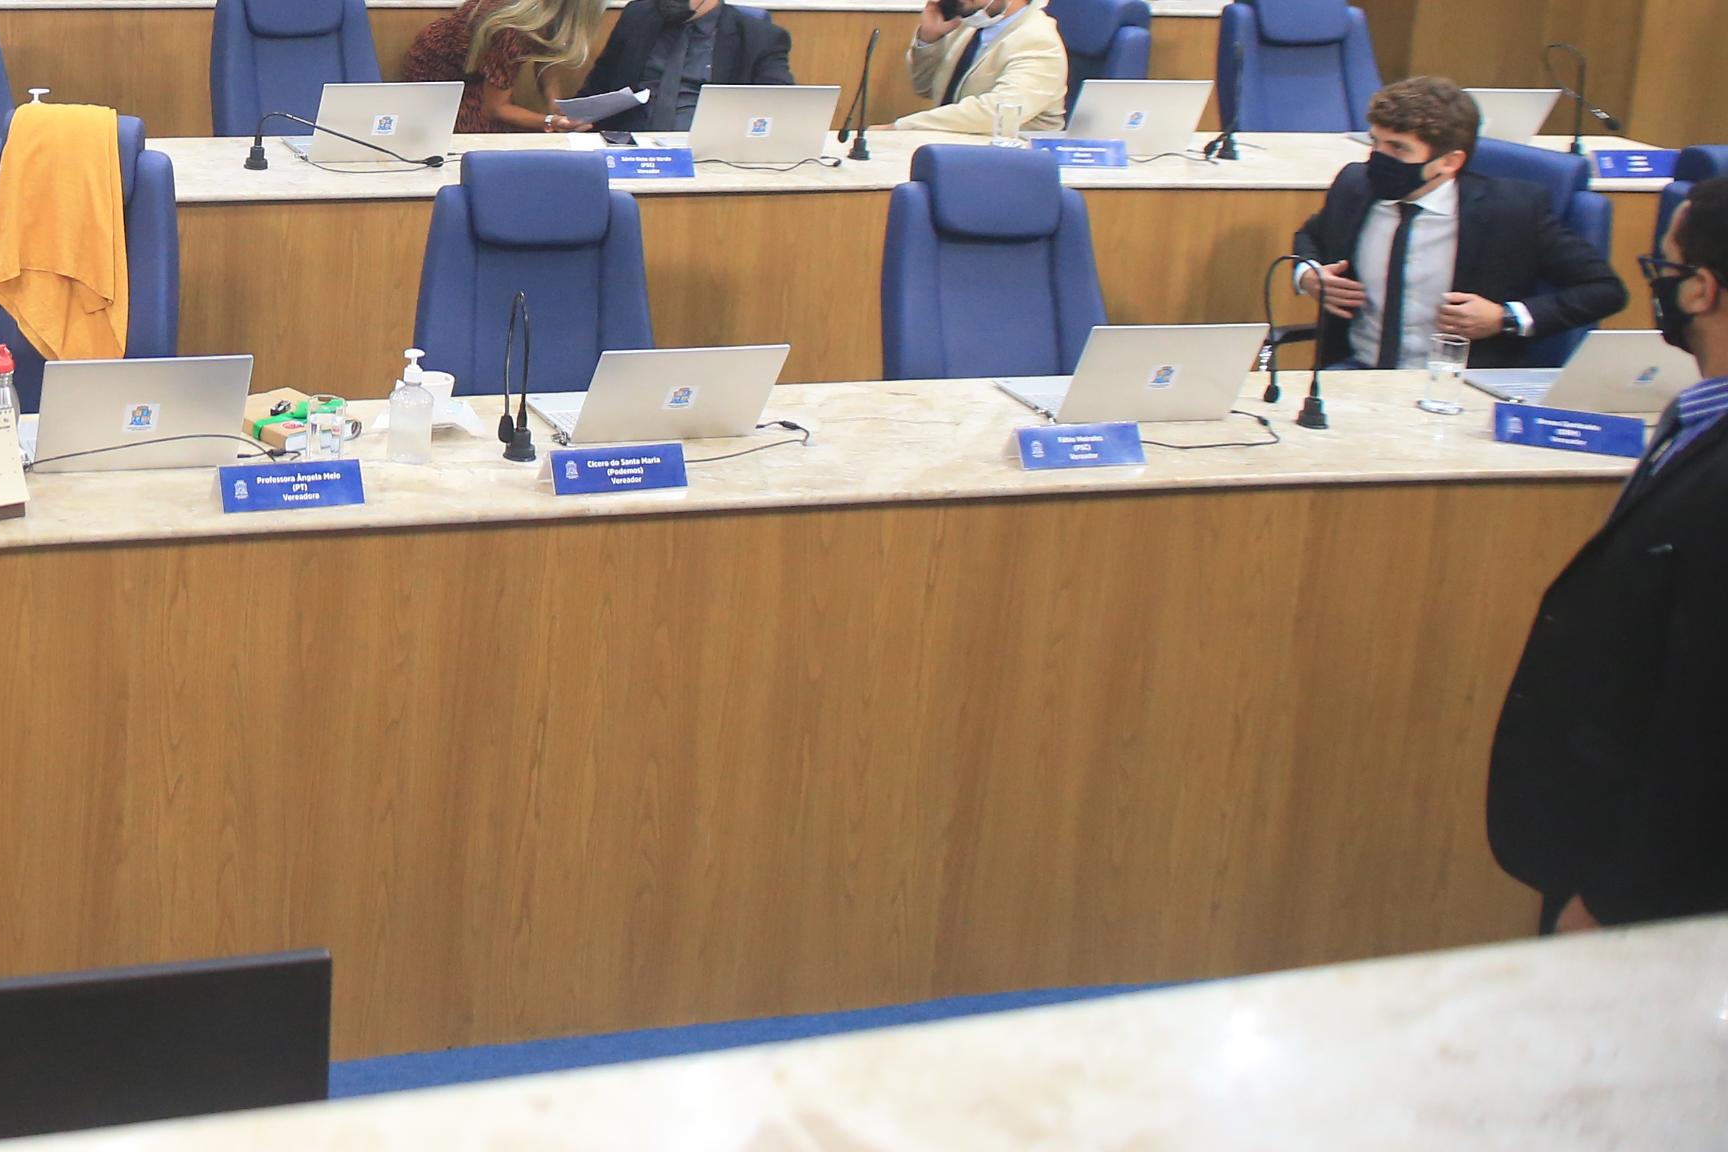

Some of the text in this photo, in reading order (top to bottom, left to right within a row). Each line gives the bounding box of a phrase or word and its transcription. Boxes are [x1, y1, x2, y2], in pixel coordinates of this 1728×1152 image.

[1068, 452, 1100, 460] Vereador
[609, 459, 620, 467] do
[620, 457, 641, 466] Santa
[640, 456, 662, 465] Maria
[606, 466, 644, 477] (Podemos)
[256, 471, 342, 485] Professora Ângela Melo
[610, 476, 643, 485] Vereador
[292, 482, 308, 492] (PT)
[282, 492, 321, 502] Vereadora
